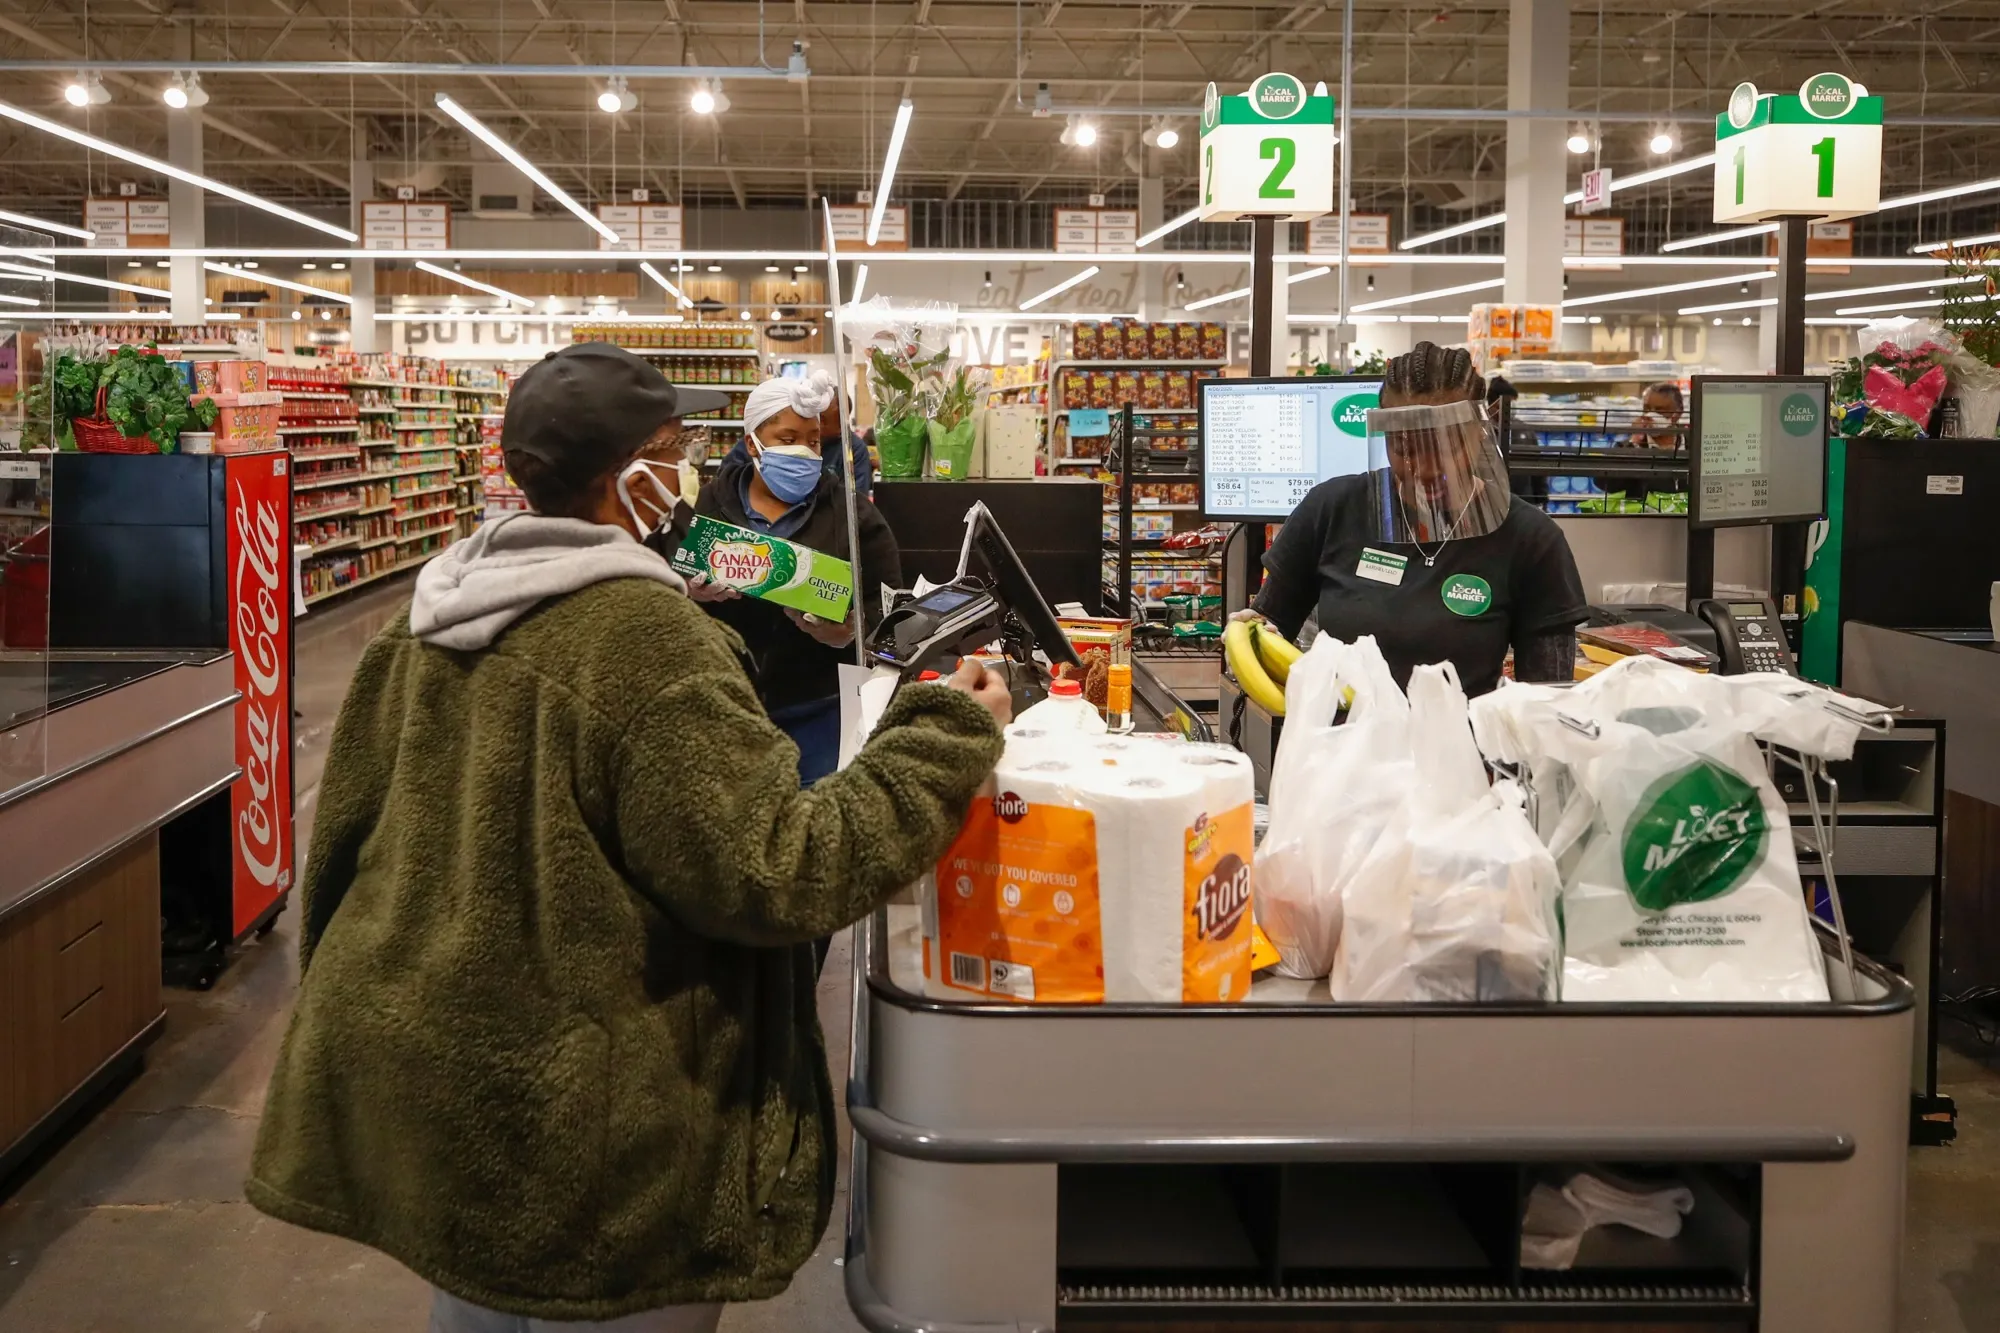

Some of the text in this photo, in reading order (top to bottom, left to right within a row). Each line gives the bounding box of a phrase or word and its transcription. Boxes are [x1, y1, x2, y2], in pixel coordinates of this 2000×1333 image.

[1264, 85, 1292, 96] LOCAL
[1815, 85, 1843, 95] LOCAL
[1260, 95, 1296, 103] MARKET
[1811, 93, 1847, 103] MARKET
[1258, 137, 1296, 199] 2
[1811, 136, 1836, 198] 1
[1205, 144, 1213, 206] 2
[1732, 145, 1746, 206] 1
[125, 184, 132, 194] 3
[1787, 406, 1812, 415] LOCAL
[1339, 414, 1368, 423] MAR
[1783, 413, 1815, 422] MARKET
[1216, 482, 1242, 490] $58.64
[1287, 479, 1314, 487] $79.98
[1292, 488, 1309, 496] $3.5
[709, 550, 773, 569] CANADA
[1362, 552, 1405, 568] LOCAL MARKET
[725, 566, 758, 581] DRY
[808, 576, 850, 597] GINGER
[1451, 583, 1484, 596] LOCAL
[815, 589, 838, 603] ALE
[1446, 591, 1488, 604] MARKET
[236, 477, 281, 887] Coca-Cola
[993, 796, 1029, 816] fiora
[1005, 866, 1028, 881] YOU
[1028, 869, 1078, 888] COVERED
[1196, 864, 1251, 935] fiora
